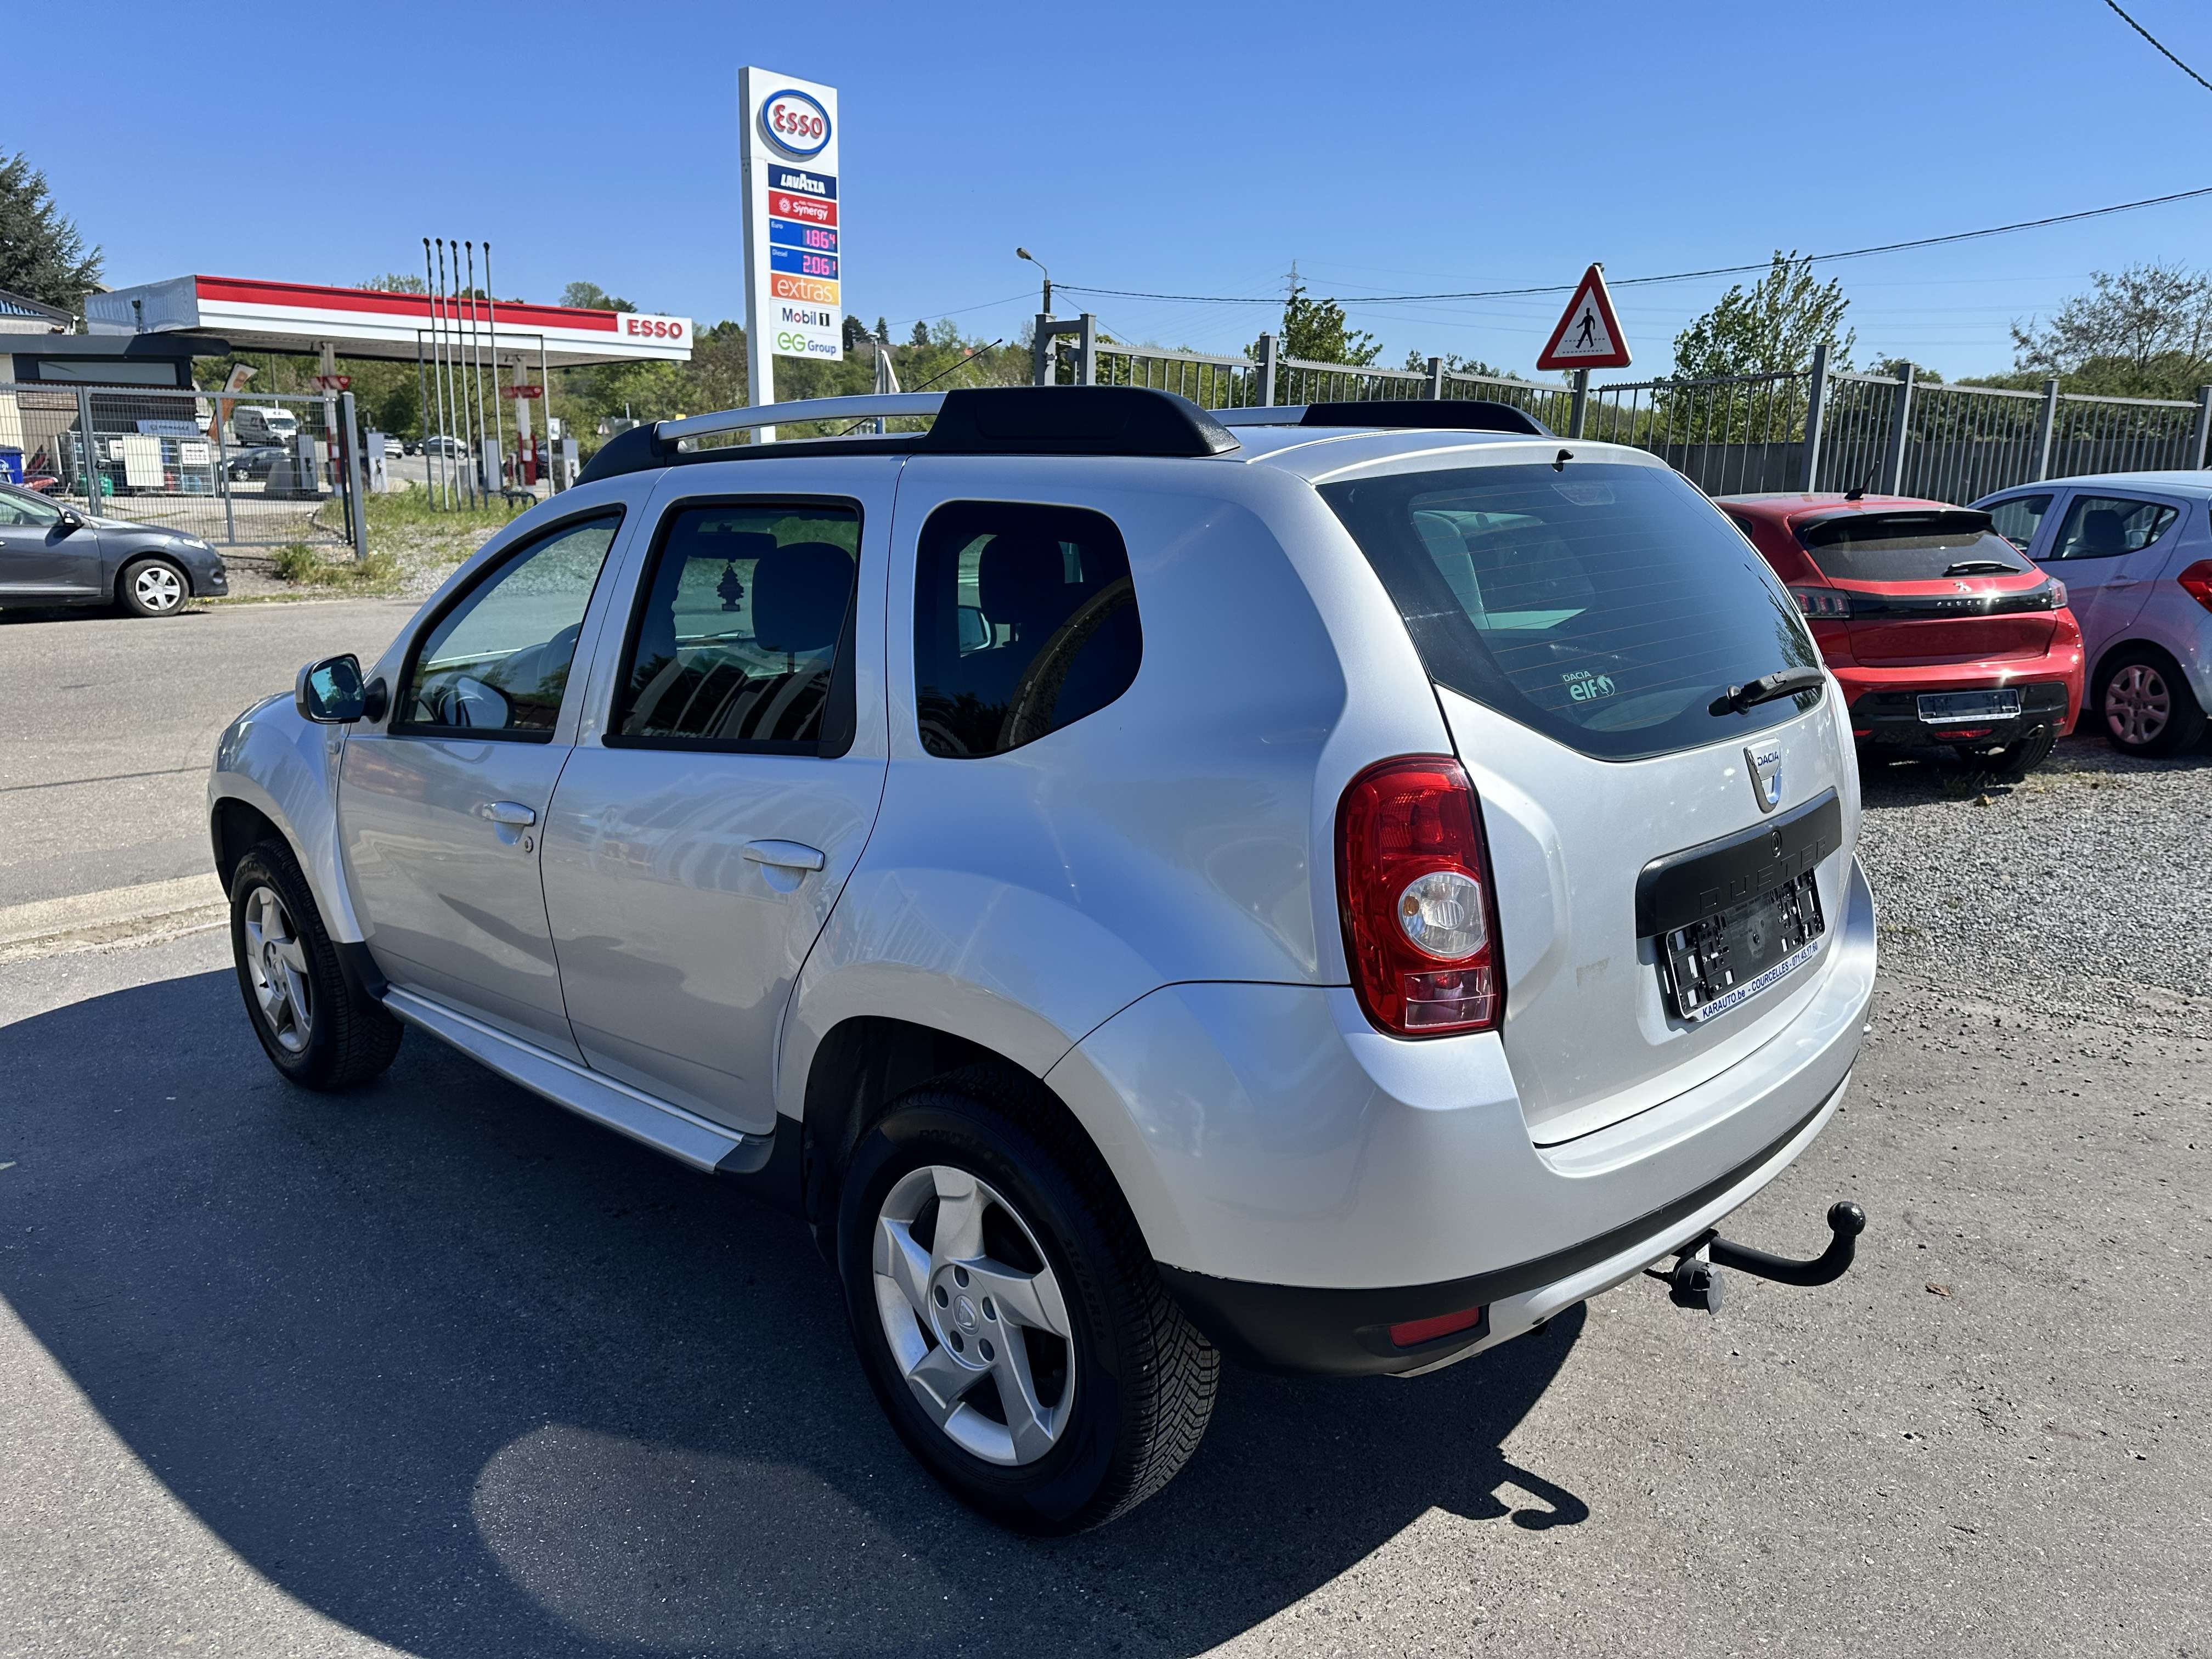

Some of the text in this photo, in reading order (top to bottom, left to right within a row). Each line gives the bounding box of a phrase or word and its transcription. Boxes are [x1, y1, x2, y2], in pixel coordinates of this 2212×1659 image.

[780, 173, 826, 194] LAVAZZA
[793, 201, 828, 221] Synergy
[777, 279, 833, 302] extras
[782, 307, 816, 325] Mobil
[627, 319, 682, 340] ESSO
[808, 340, 837, 356] Group
[1562, 670, 1592, 682] DACIA
[1570, 679, 1598, 701] elf
[1757, 751, 1779, 766] DACIA
[1702, 990, 1745, 1019] KARAUTO.be
[1752, 961, 1789, 992] COURCELLES
[1792, 941, 1818, 967] 071.45.17.60
